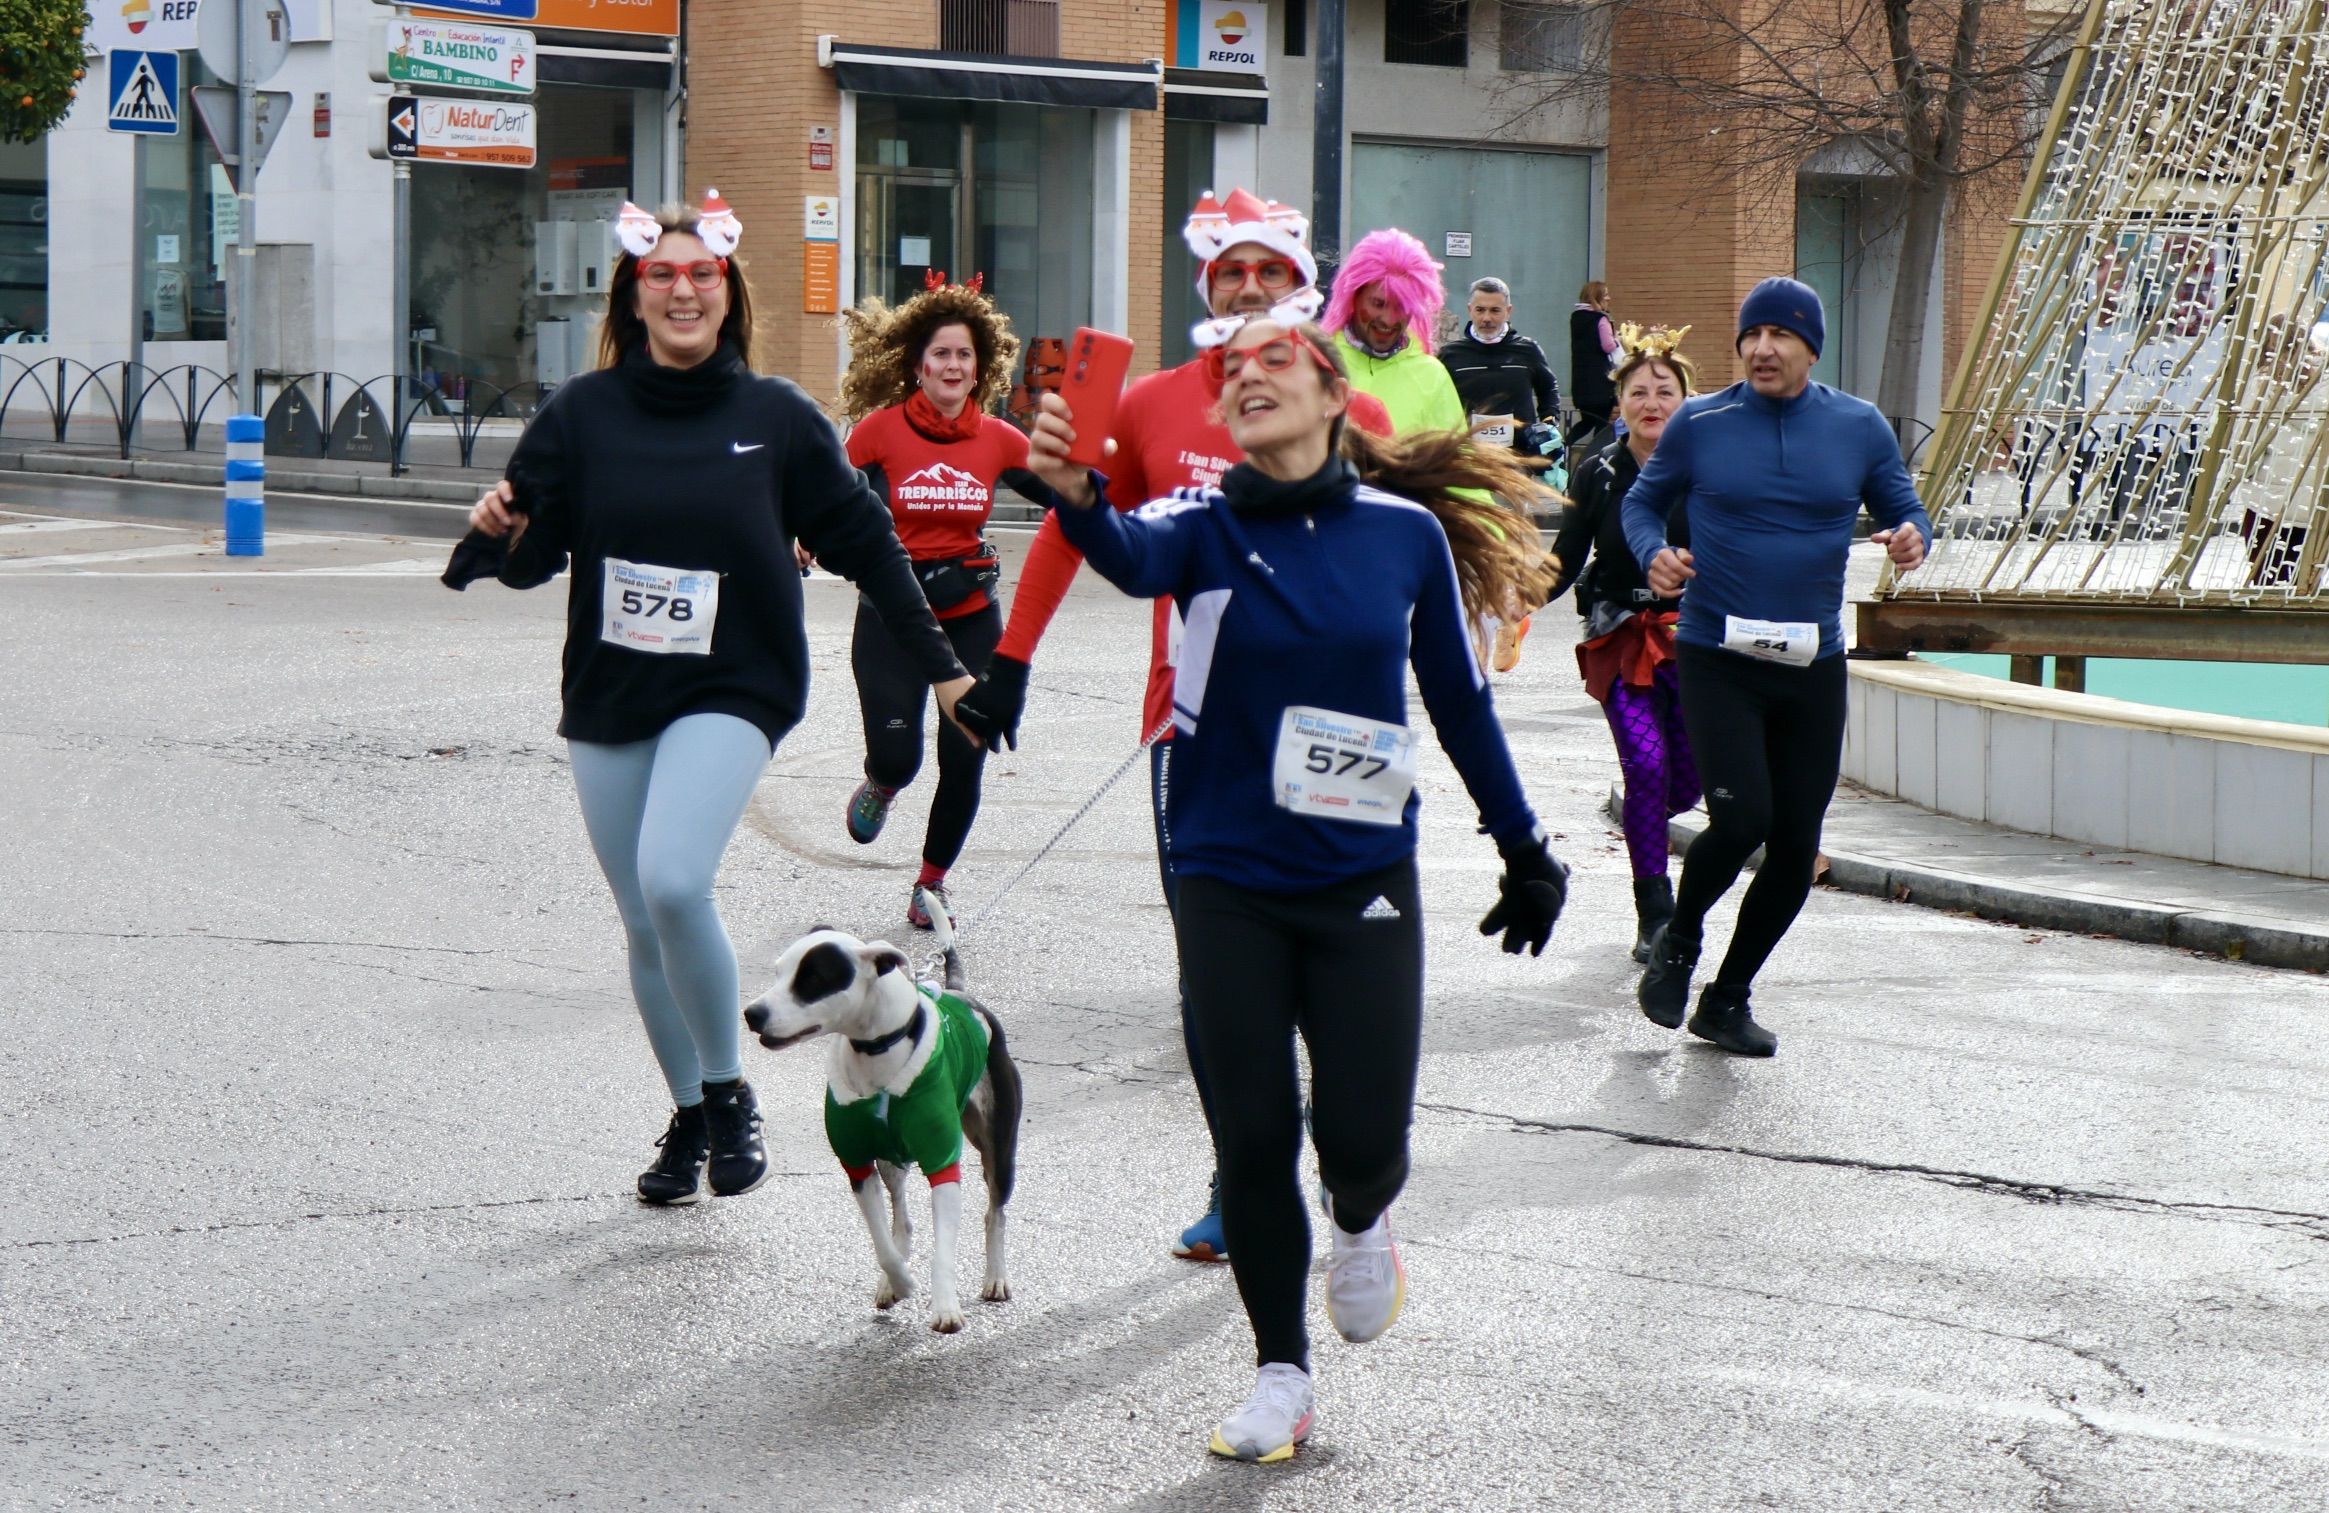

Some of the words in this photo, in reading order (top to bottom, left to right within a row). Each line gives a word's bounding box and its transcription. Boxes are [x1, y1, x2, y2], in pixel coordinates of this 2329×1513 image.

[162, 1, 196, 21] REP
[413, 25, 436, 37] Centro
[448, 29, 481, 42] Educación
[483, 33, 506, 45] Infantil
[423, 40, 498, 62] BAMBINO
[1209, 51, 1255, 64] REPSOL
[411, 65, 419, 77] C/
[420, 65, 438, 79] Arena
[443, 69, 453, 81] 10
[447, 106, 530, 132] NaturDent
[487, 153, 499, 161] 957
[1179, 450, 1187, 463] I
[1187, 452, 1209, 468] San
[1210, 456, 1234, 471] Silv
[898, 486, 988, 502] TREPARRISCOS
[907, 502, 931, 510] Unidos
[933, 503, 945, 511] por
[948, 502, 955, 510] la
[957, 503, 984, 511] Montaña
[614, 575, 636, 586] Ciudad
[645, 582, 671, 592] Lucena
[621, 589, 694, 621] 578
[1753, 639, 1788, 652] 54
[1298, 715, 1314, 728] San
[1295, 725, 1324, 738] Ciudad
[1326, 732, 1337, 741] de
[1338, 734, 1368, 748] Lucena
[1305, 743, 1390, 780] 577
[1363, 909, 1401, 917] adidas
